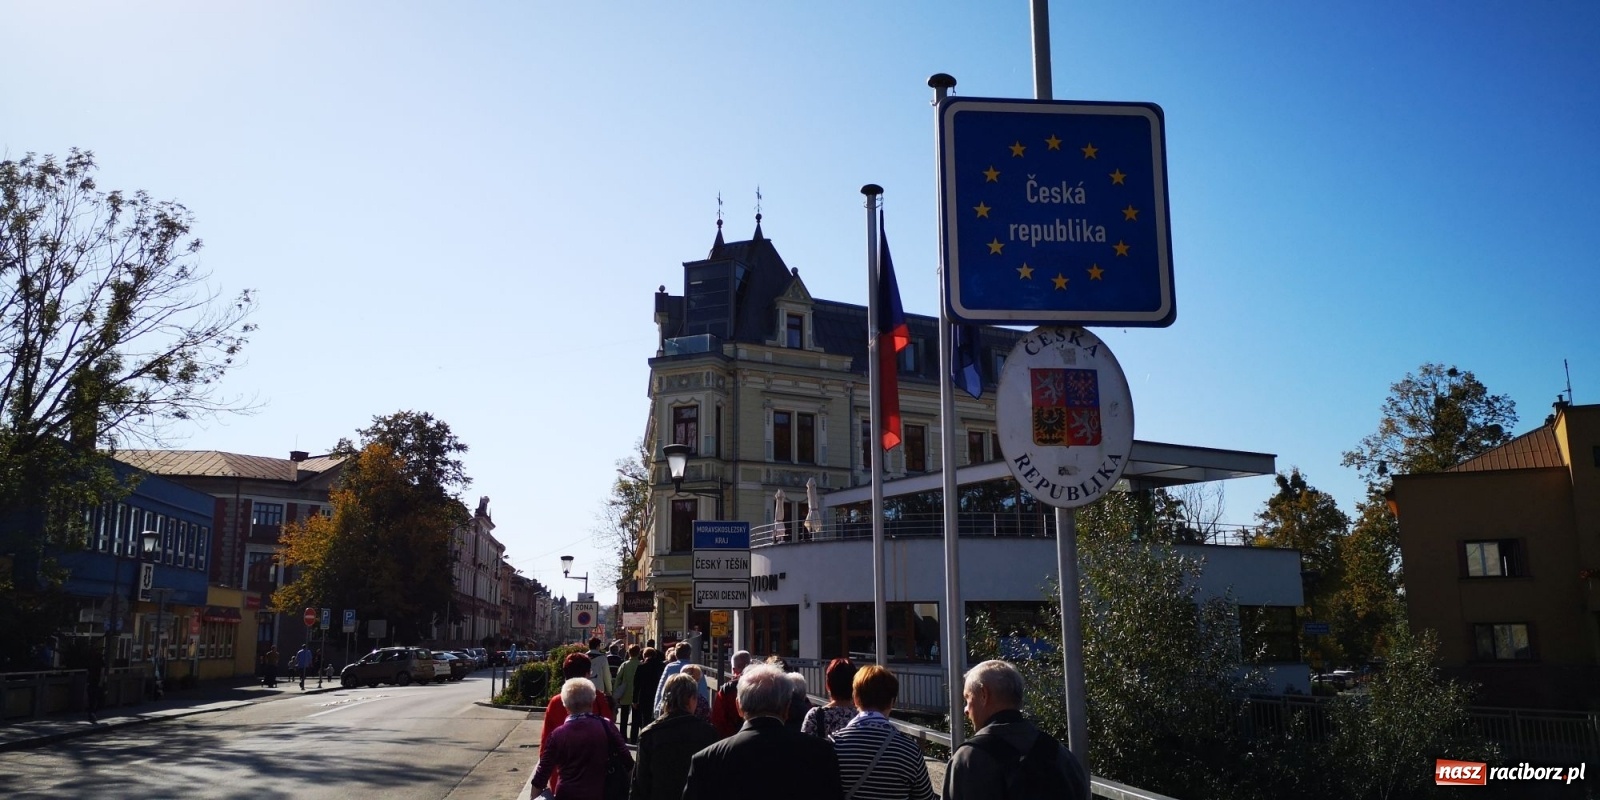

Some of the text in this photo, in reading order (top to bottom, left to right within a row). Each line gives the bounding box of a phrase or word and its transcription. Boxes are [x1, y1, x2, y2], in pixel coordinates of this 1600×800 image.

[1026, 174, 1086, 204] Česká
[1009, 218, 1106, 248] republika
[1014, 453, 1122, 501] REPUBLIKA
[714, 537, 729, 545] KRAJ
[695, 557, 748, 570] ČESKÝ TĚŠÍN
[697, 590, 747, 600] CZESKI CIESZYN
